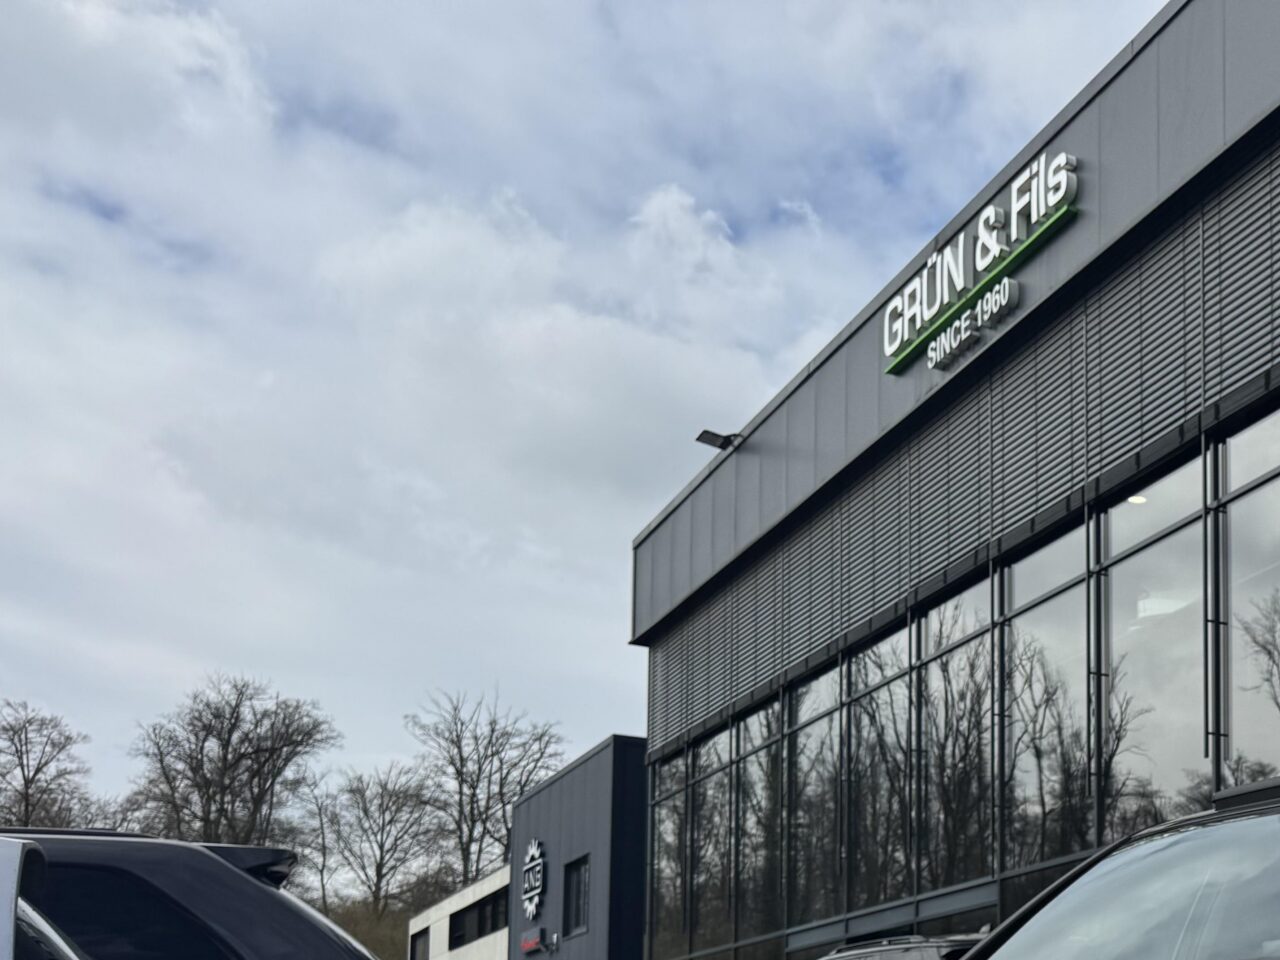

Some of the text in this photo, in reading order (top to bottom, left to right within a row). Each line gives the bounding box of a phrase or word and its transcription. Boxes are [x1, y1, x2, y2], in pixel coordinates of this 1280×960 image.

[883, 152, 1074, 357] GRÜN & Fils
[926, 276, 1012, 370] SINCE 1960
